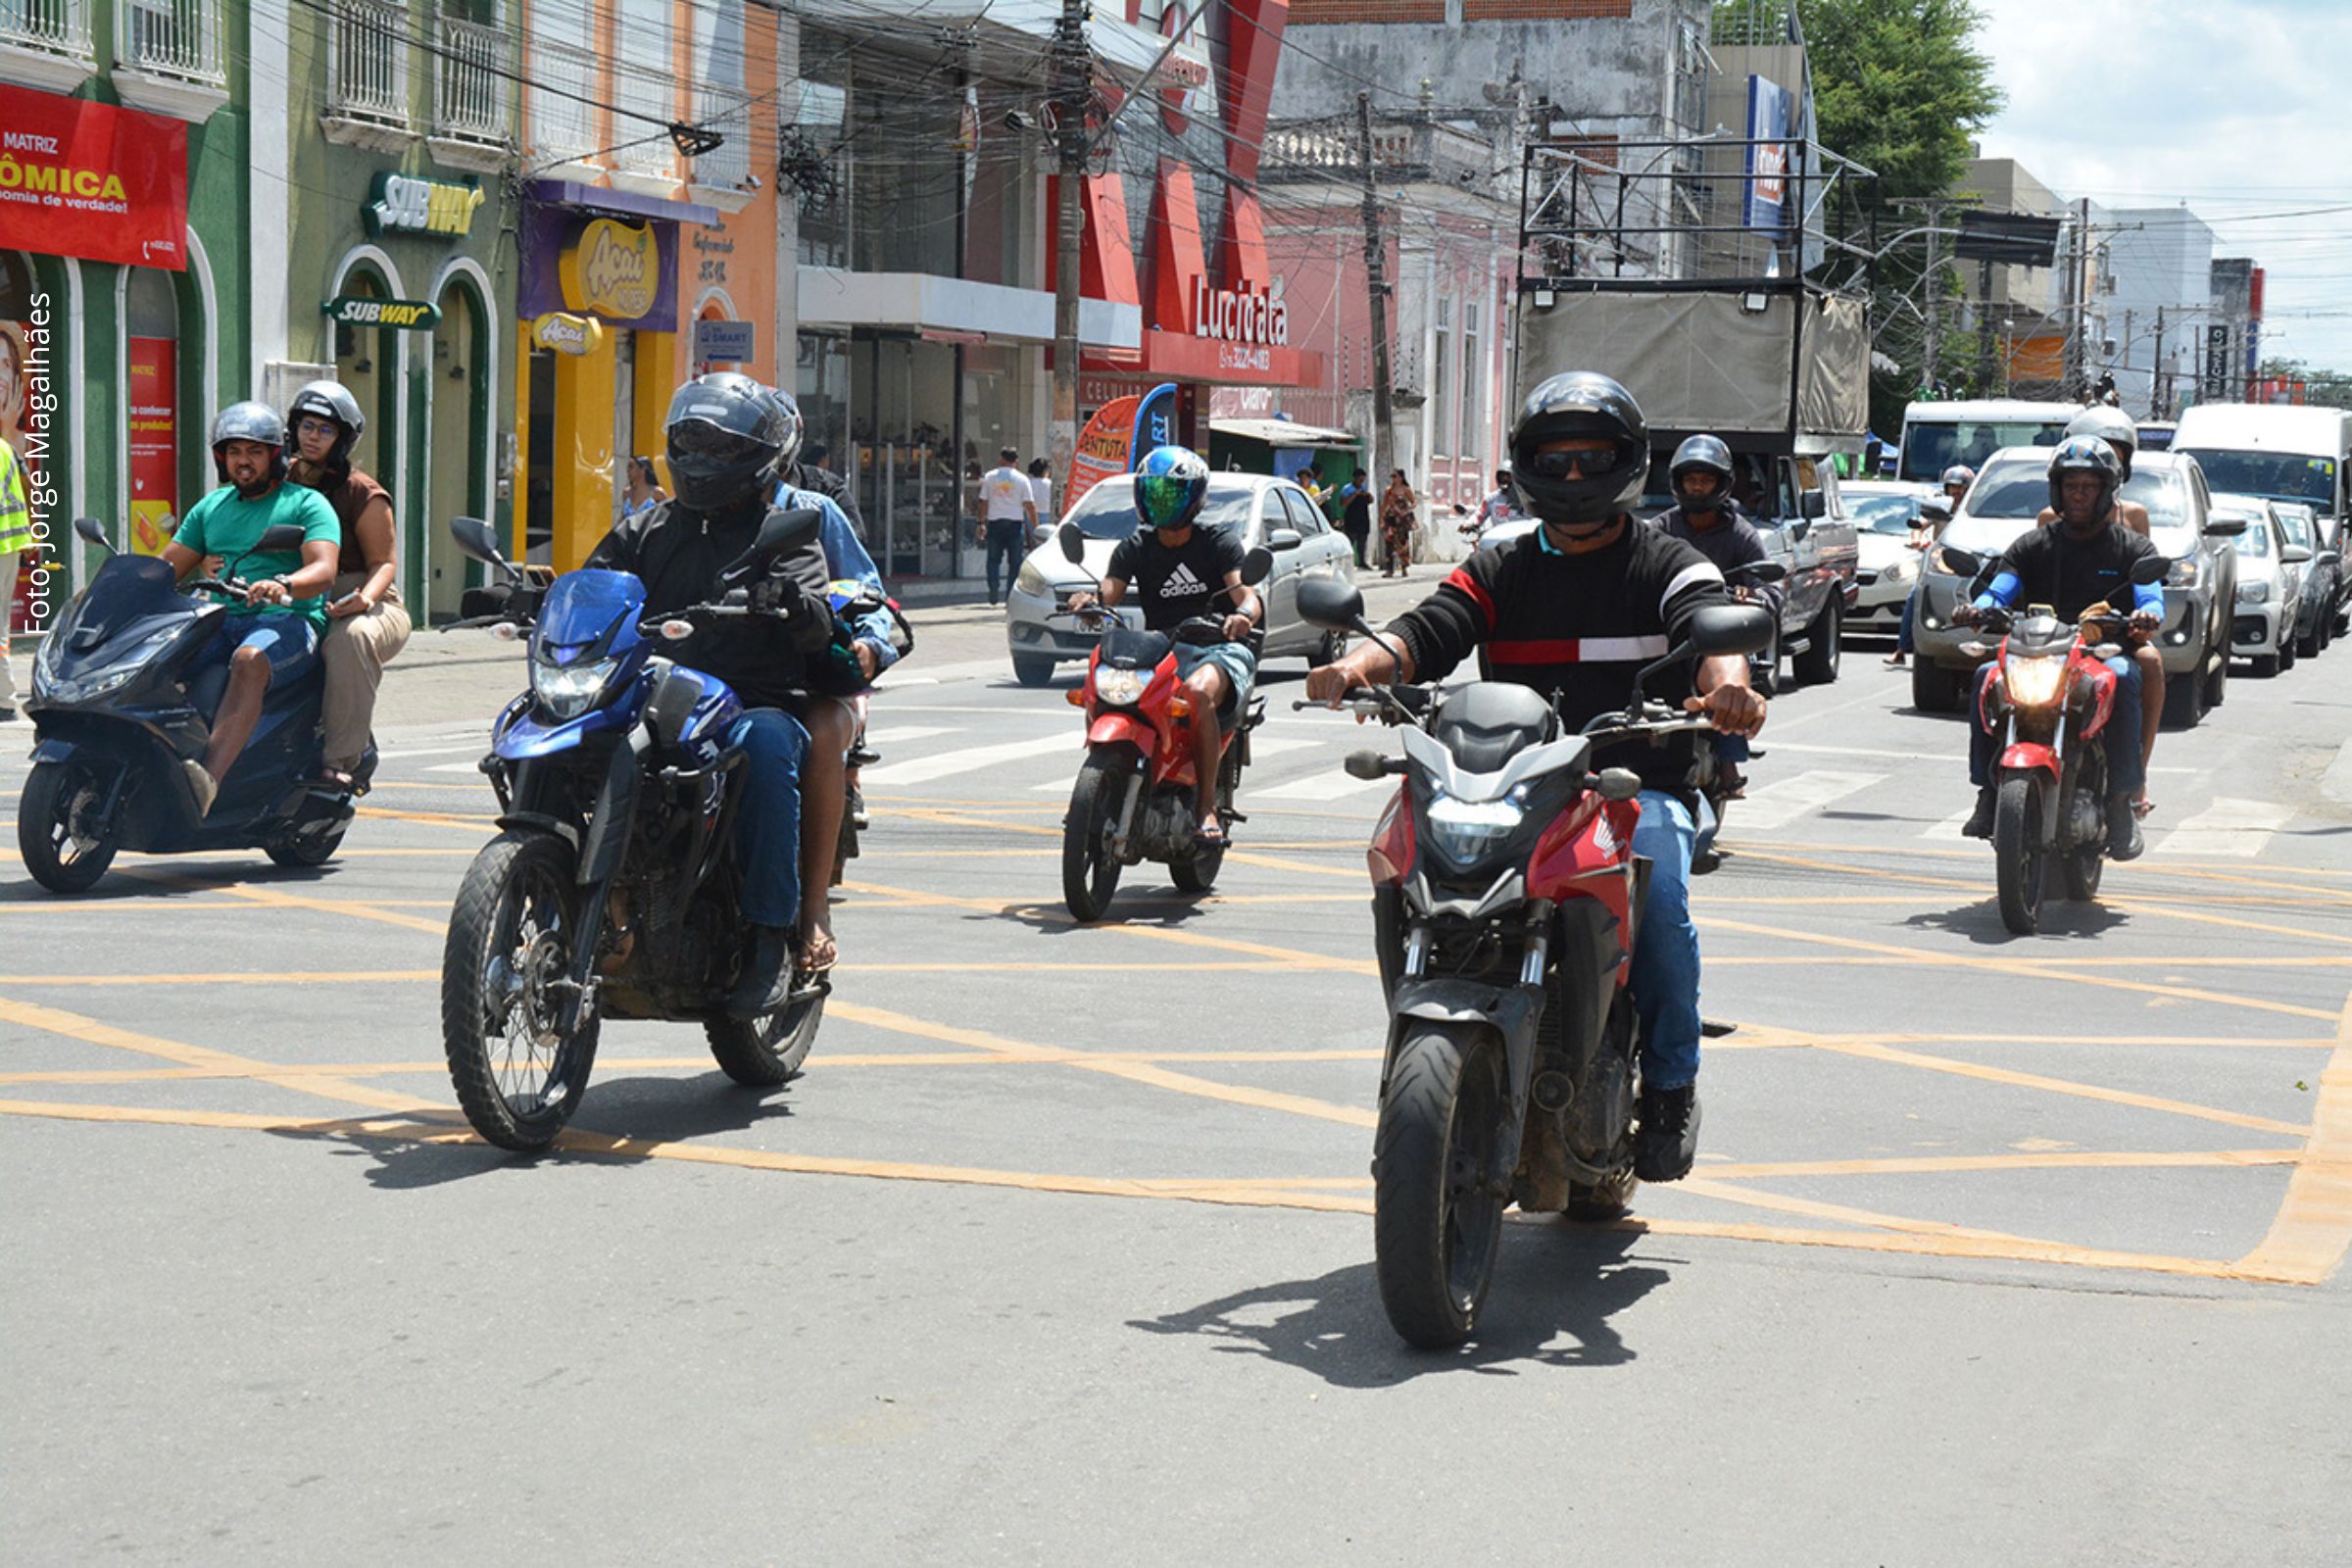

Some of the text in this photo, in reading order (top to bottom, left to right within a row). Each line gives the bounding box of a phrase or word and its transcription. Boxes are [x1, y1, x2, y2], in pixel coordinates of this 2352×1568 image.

[4, 131, 58, 155] MATRIZ
[43, 194, 62, 207] de
[66, 198, 127, 214] verdade!
[371, 174, 486, 235] SUBWAY
[338, 301, 429, 325] SUBWAY
[1196, 274, 1289, 346] Lucidata
[1160, 582, 1207, 598] adidas
